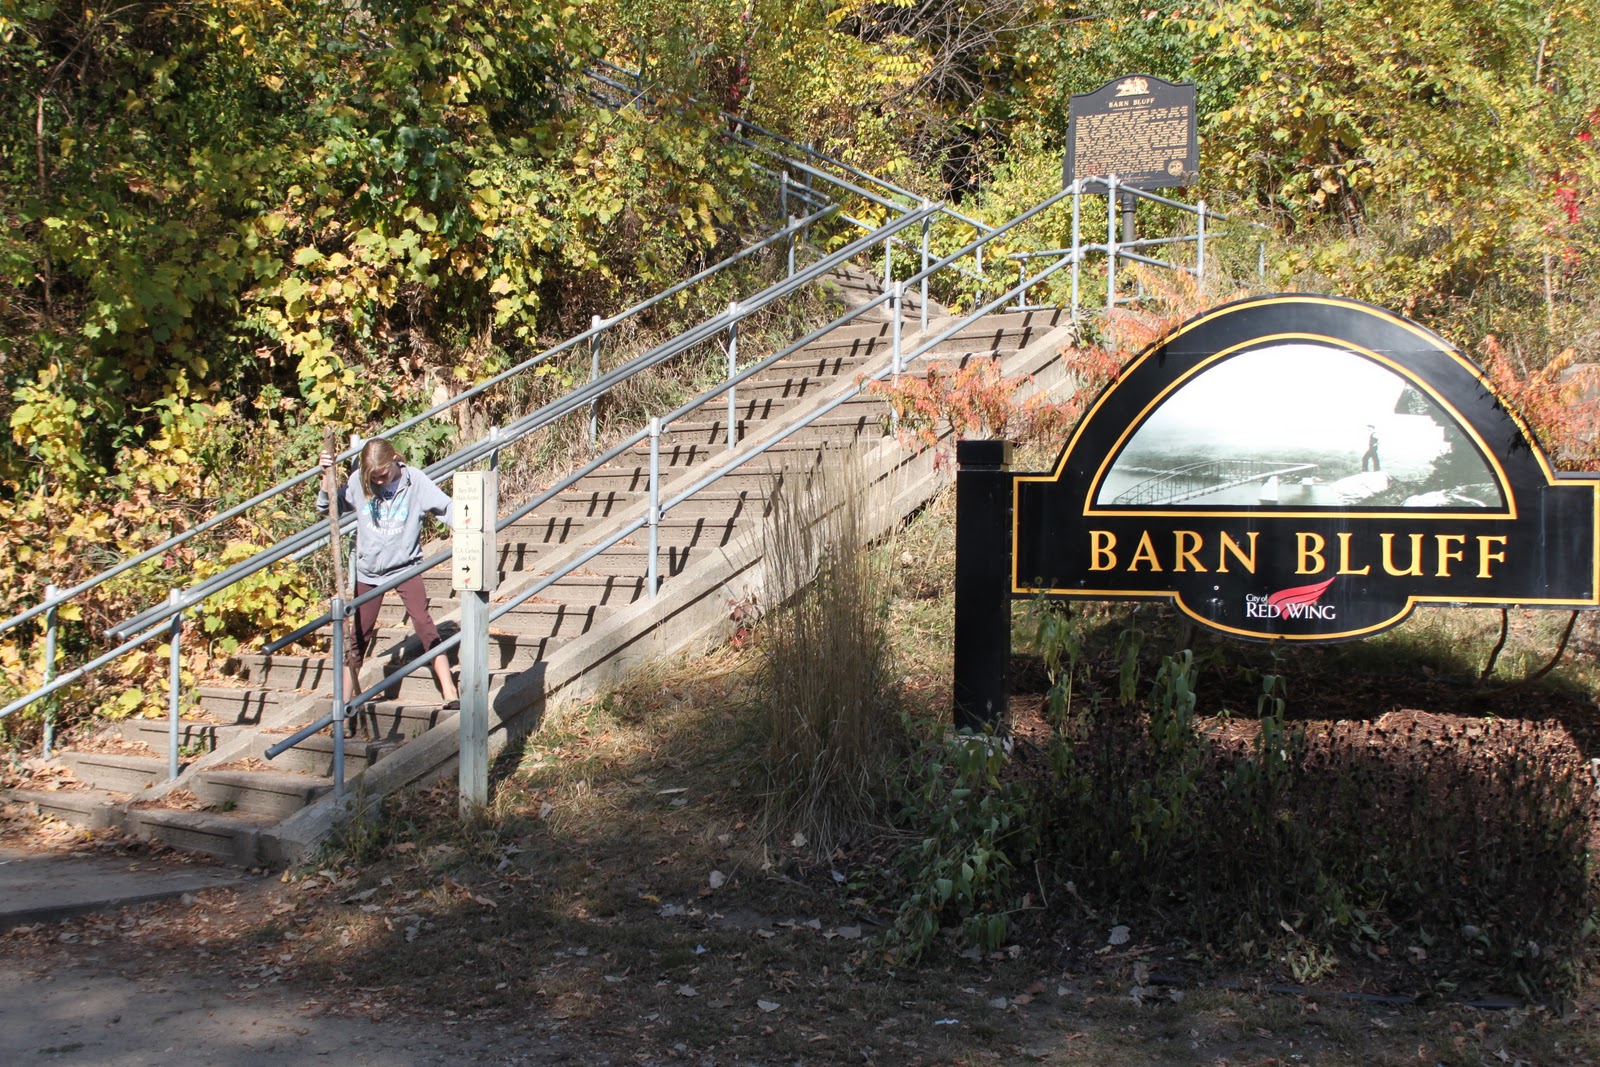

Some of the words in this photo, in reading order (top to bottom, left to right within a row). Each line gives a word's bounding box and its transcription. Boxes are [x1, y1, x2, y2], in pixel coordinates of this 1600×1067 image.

[1108, 100, 1130, 108] BARN
[1133, 97, 1155, 105] BLUFF
[1088, 530, 1260, 574] BARN
[1295, 532, 1507, 578] BLUFF
[1245, 593, 1261, 603] City
[1260, 594, 1268, 602] of
[1246, 602, 1281, 618] RED
[1286, 603, 1336, 620] WING
